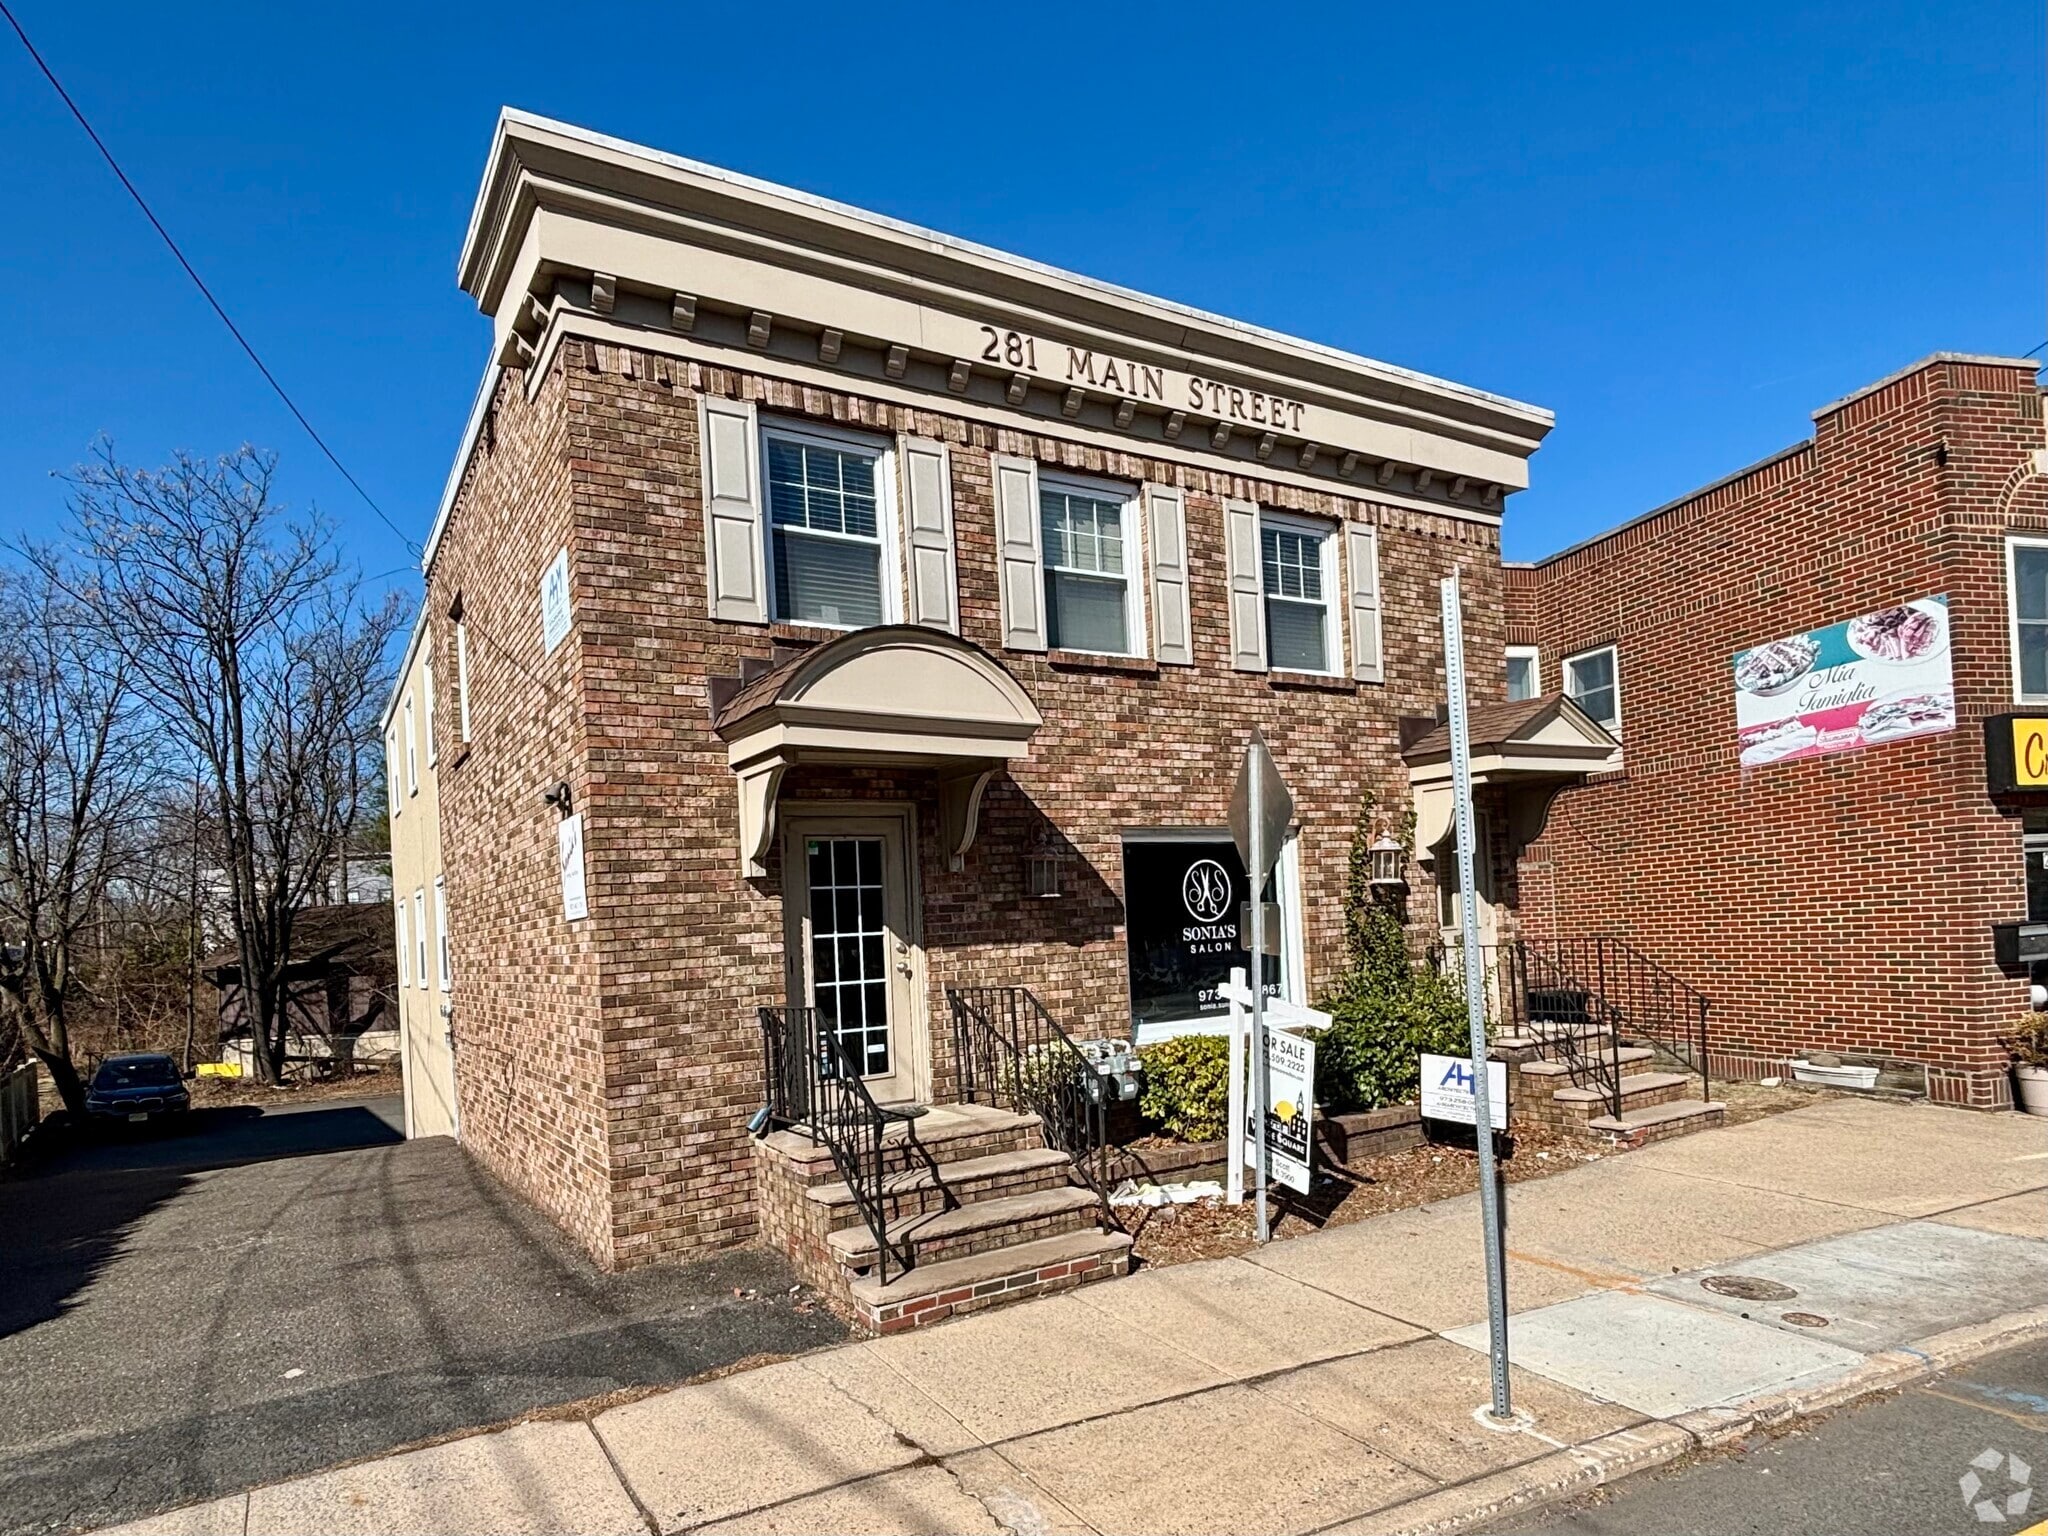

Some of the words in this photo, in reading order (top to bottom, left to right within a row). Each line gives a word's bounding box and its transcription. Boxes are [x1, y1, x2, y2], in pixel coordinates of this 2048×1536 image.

[980, 326, 1038, 372] 281
[1066, 346, 1164, 401] MAIN
[1187, 376, 1306, 432] STREET
[1808, 664, 1856, 689] Mia
[1796, 681, 1877, 713] Famiglia
[2024, 732, 2048, 778] C
[1182, 924, 1237, 942] SONIA'S
[1190, 941, 1233, 954] SALON
[1261, 983, 1283, 996] 867
[1262, 1034, 1277, 1051] OR
[1279, 1040, 1305, 1062] SALE
[1439, 1060, 1476, 1096] AH
[1277, 1132, 1305, 1155] SQUARE
